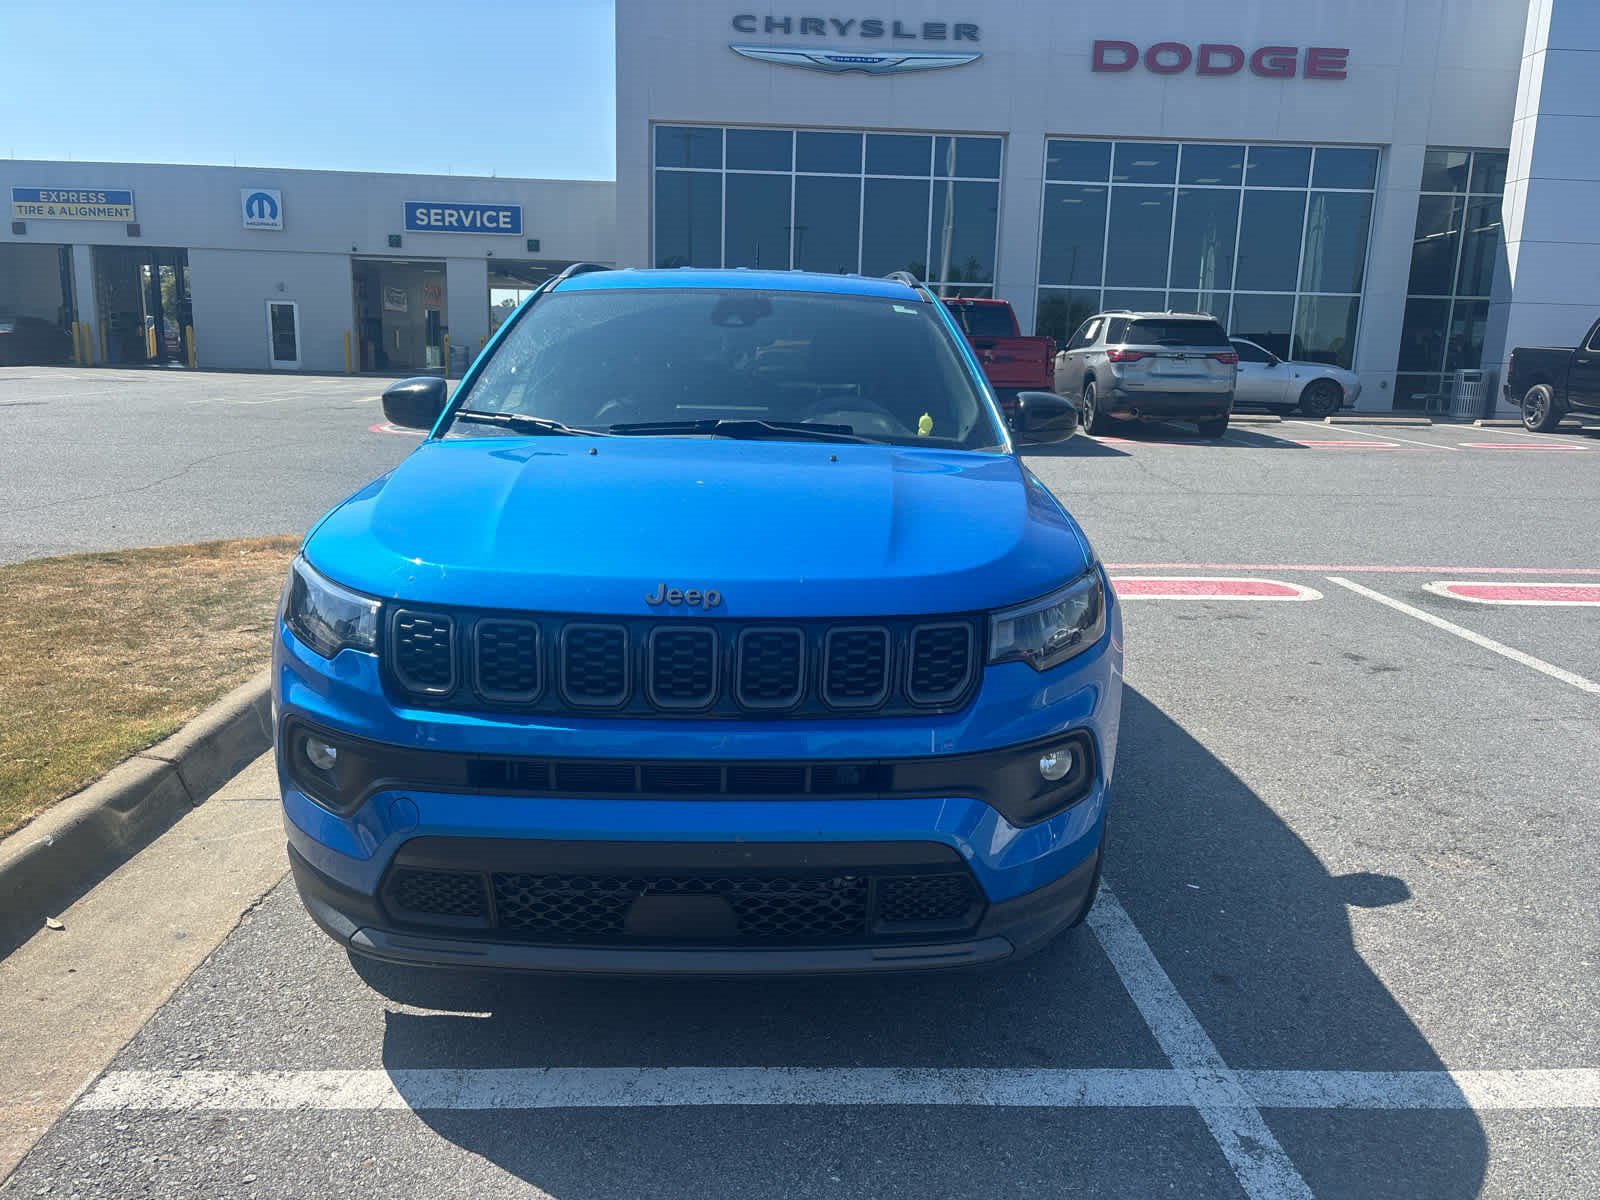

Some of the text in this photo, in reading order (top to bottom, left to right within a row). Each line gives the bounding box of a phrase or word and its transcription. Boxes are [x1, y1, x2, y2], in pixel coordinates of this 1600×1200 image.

[732, 14, 981, 42] CHRYSLER
[1092, 40, 1350, 79] DODGE
[39, 191, 107, 203] EXPRESS
[16, 205, 130, 217] TIRE & ALIGNMENT
[415, 208, 513, 228] SERVICE
[644, 583, 722, 611] Jeep
